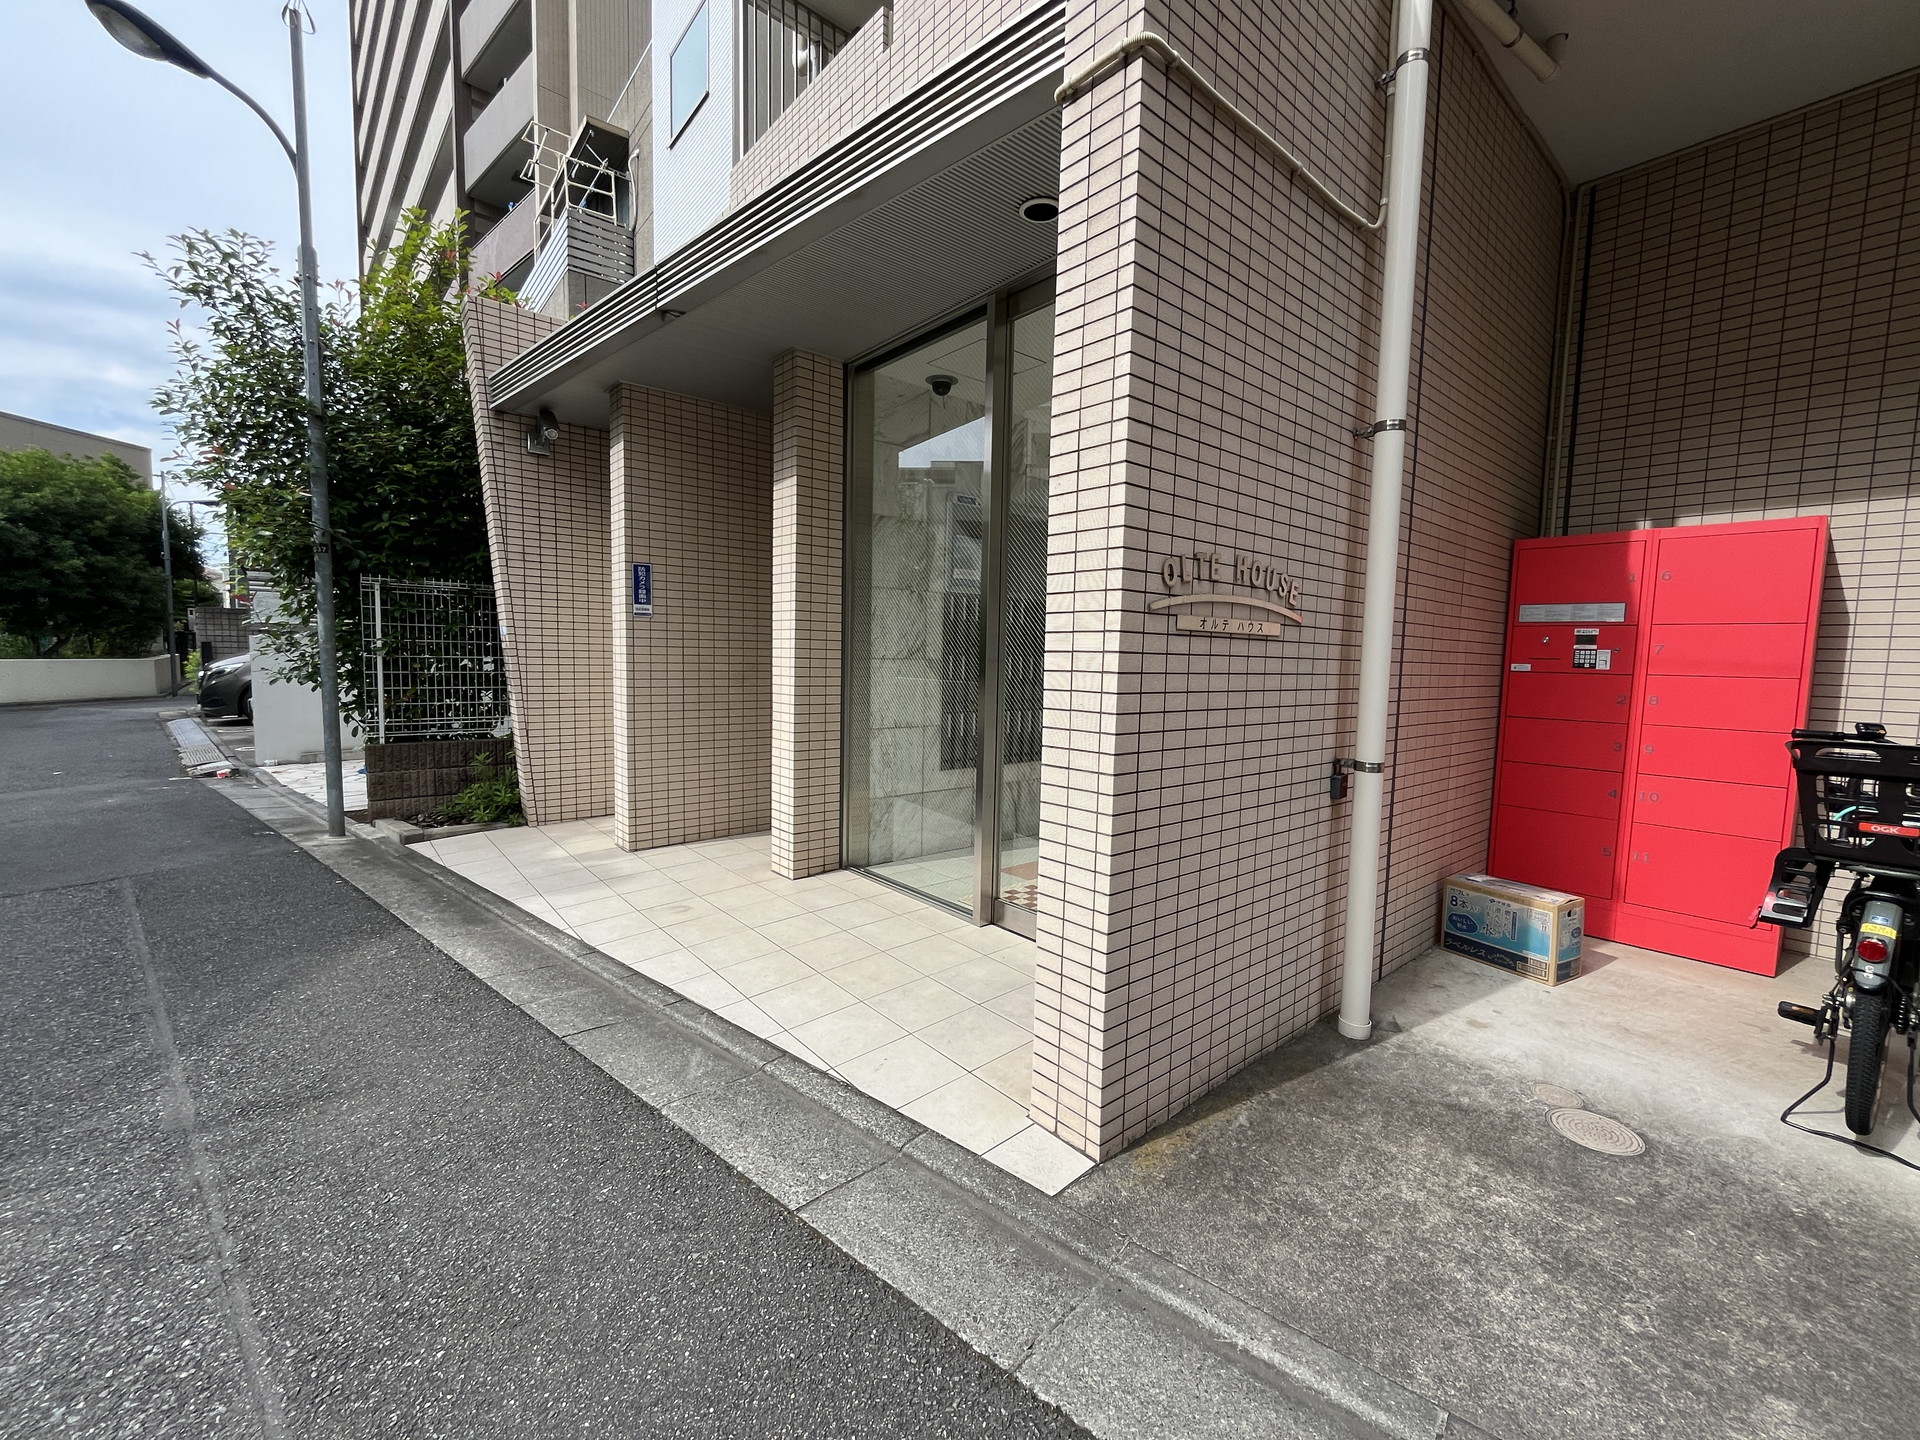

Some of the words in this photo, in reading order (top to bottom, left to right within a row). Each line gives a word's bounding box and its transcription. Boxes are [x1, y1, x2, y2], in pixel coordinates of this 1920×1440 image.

[1162, 552, 1221, 588] OLTE
[1235, 554, 1300, 606] HOUSE
[1661, 571, 1671, 581] 6
[1200, 617, 1229, 631] オルテ
[1237, 622, 1264, 633] ハウス
[1655, 644, 1664, 655] 7
[1616, 695, 1626, 705] 2
[1649, 696, 1658, 706] 8
[1612, 742, 1622, 752] 3
[1644, 744, 1654, 754] 9
[1607, 789, 1617, 799] 4
[1639, 792, 1660, 803] 10
[1871, 825, 1901, 834] OGK
[1602, 847, 1612, 857] 5
[1632, 852, 1650, 863] 11
